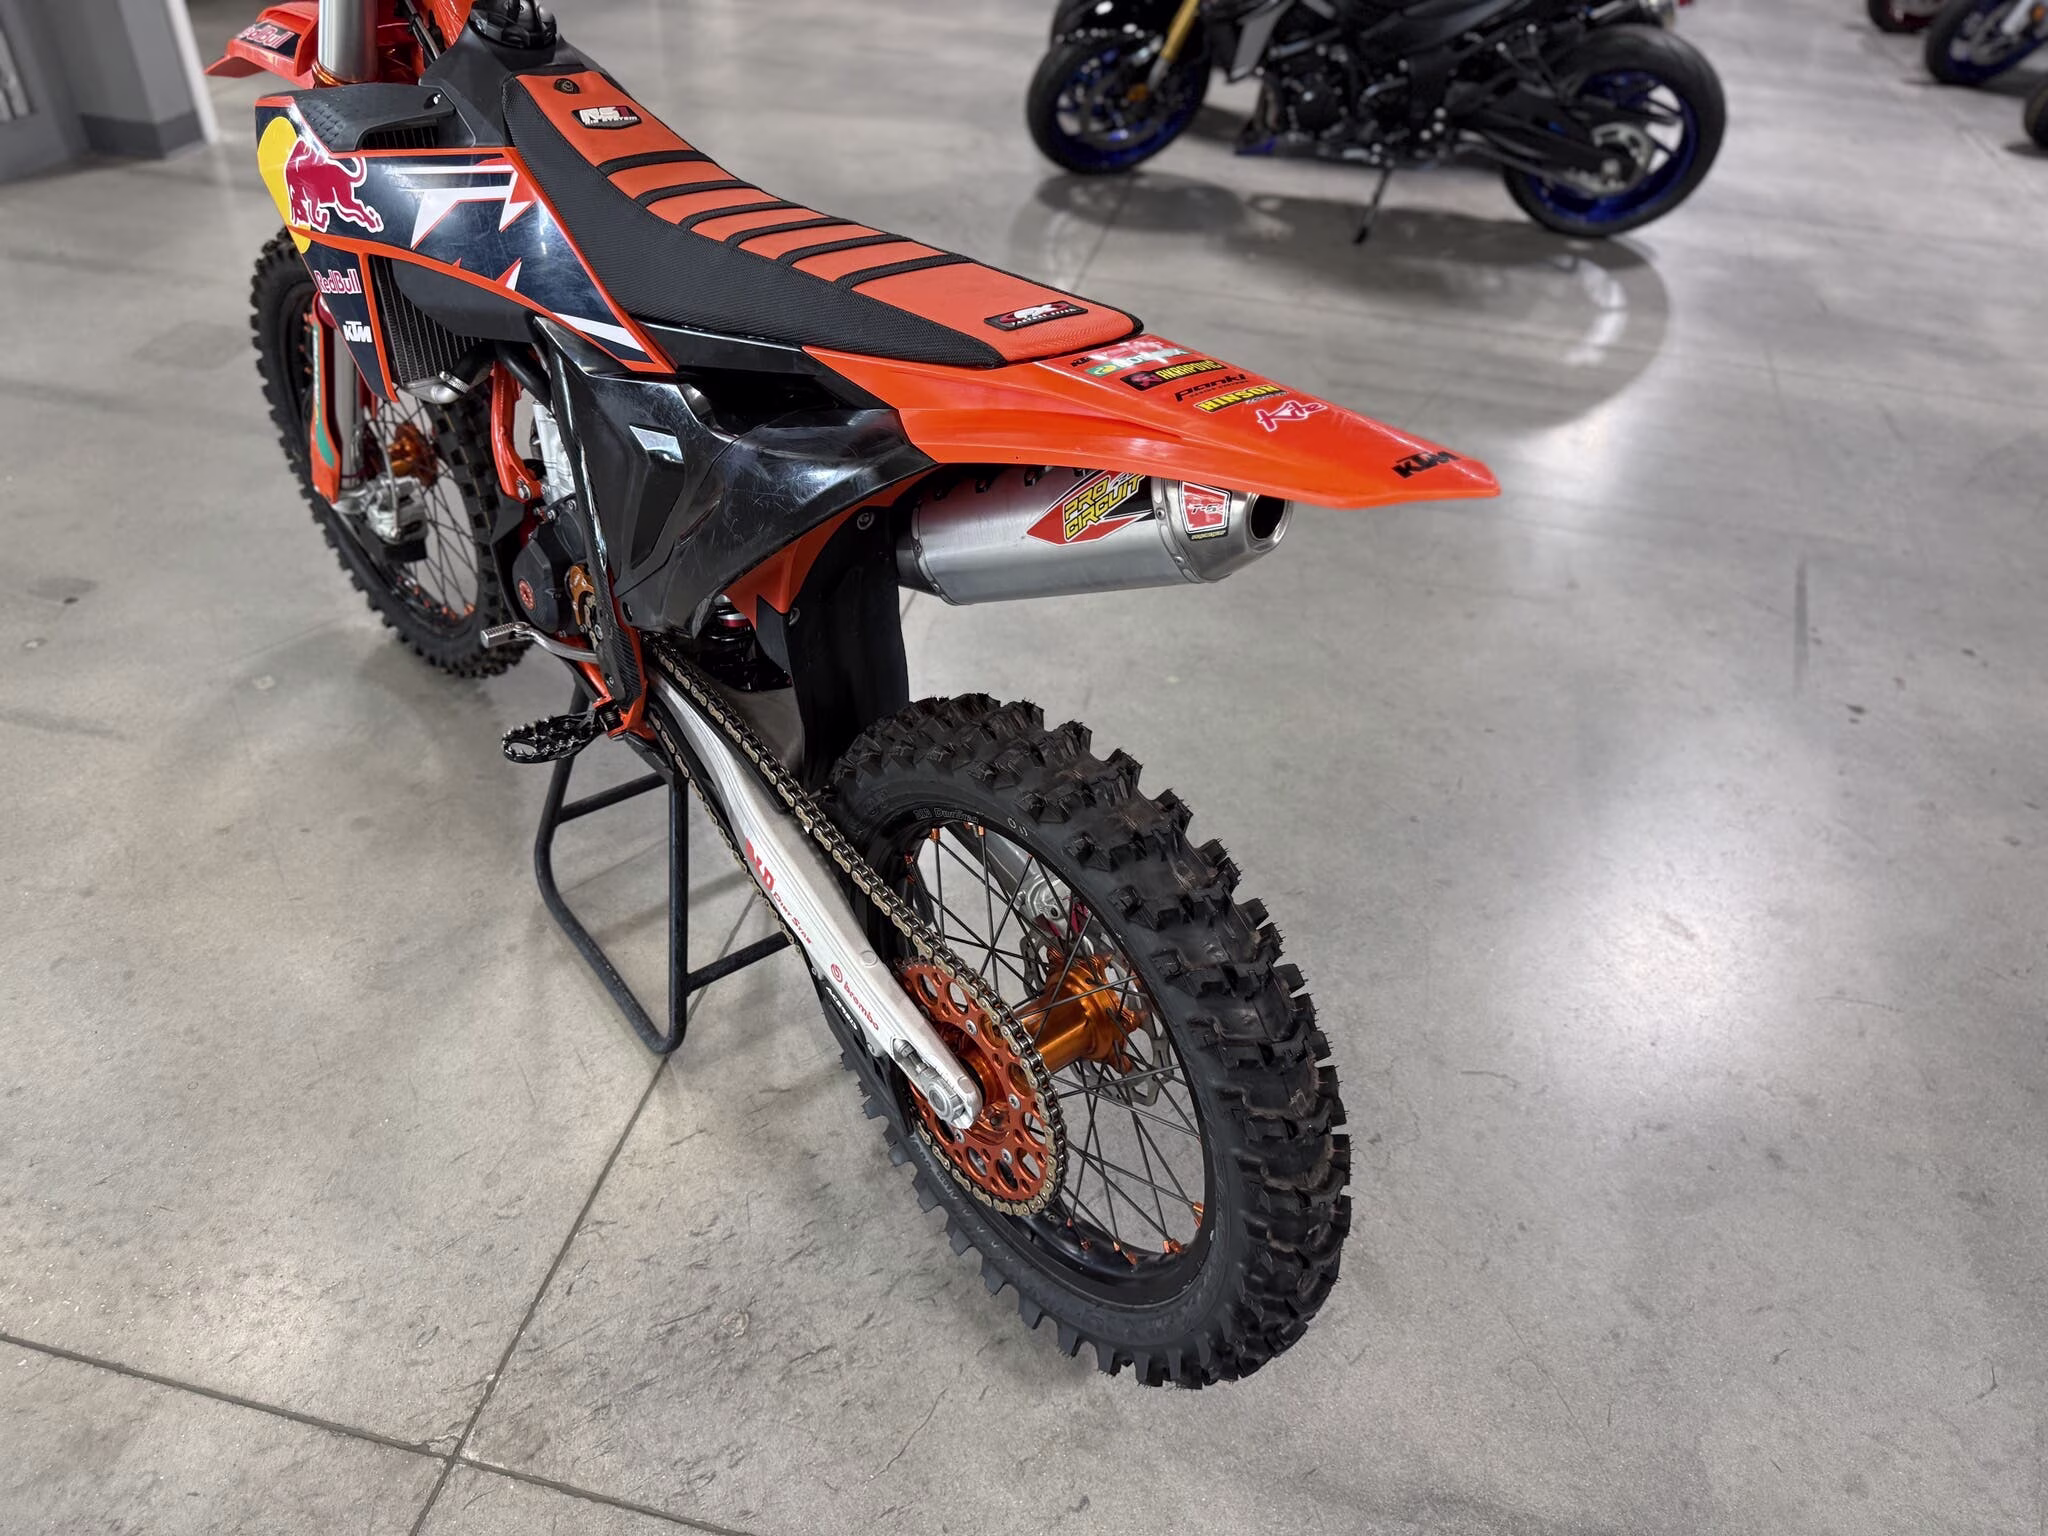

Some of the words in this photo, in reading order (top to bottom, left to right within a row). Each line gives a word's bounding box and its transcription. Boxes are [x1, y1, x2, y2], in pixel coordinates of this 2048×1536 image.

[343, 321, 372, 343] KTM
[1198, 385, 1281, 411] HINSON
[1256, 401, 1328, 431] Kite
[1392, 452, 1460, 478] KTM
[1064, 476, 1111, 522] PRO
[1064, 474, 1144, 541] CIRCUIT
[844, 981, 879, 1031] brembo
